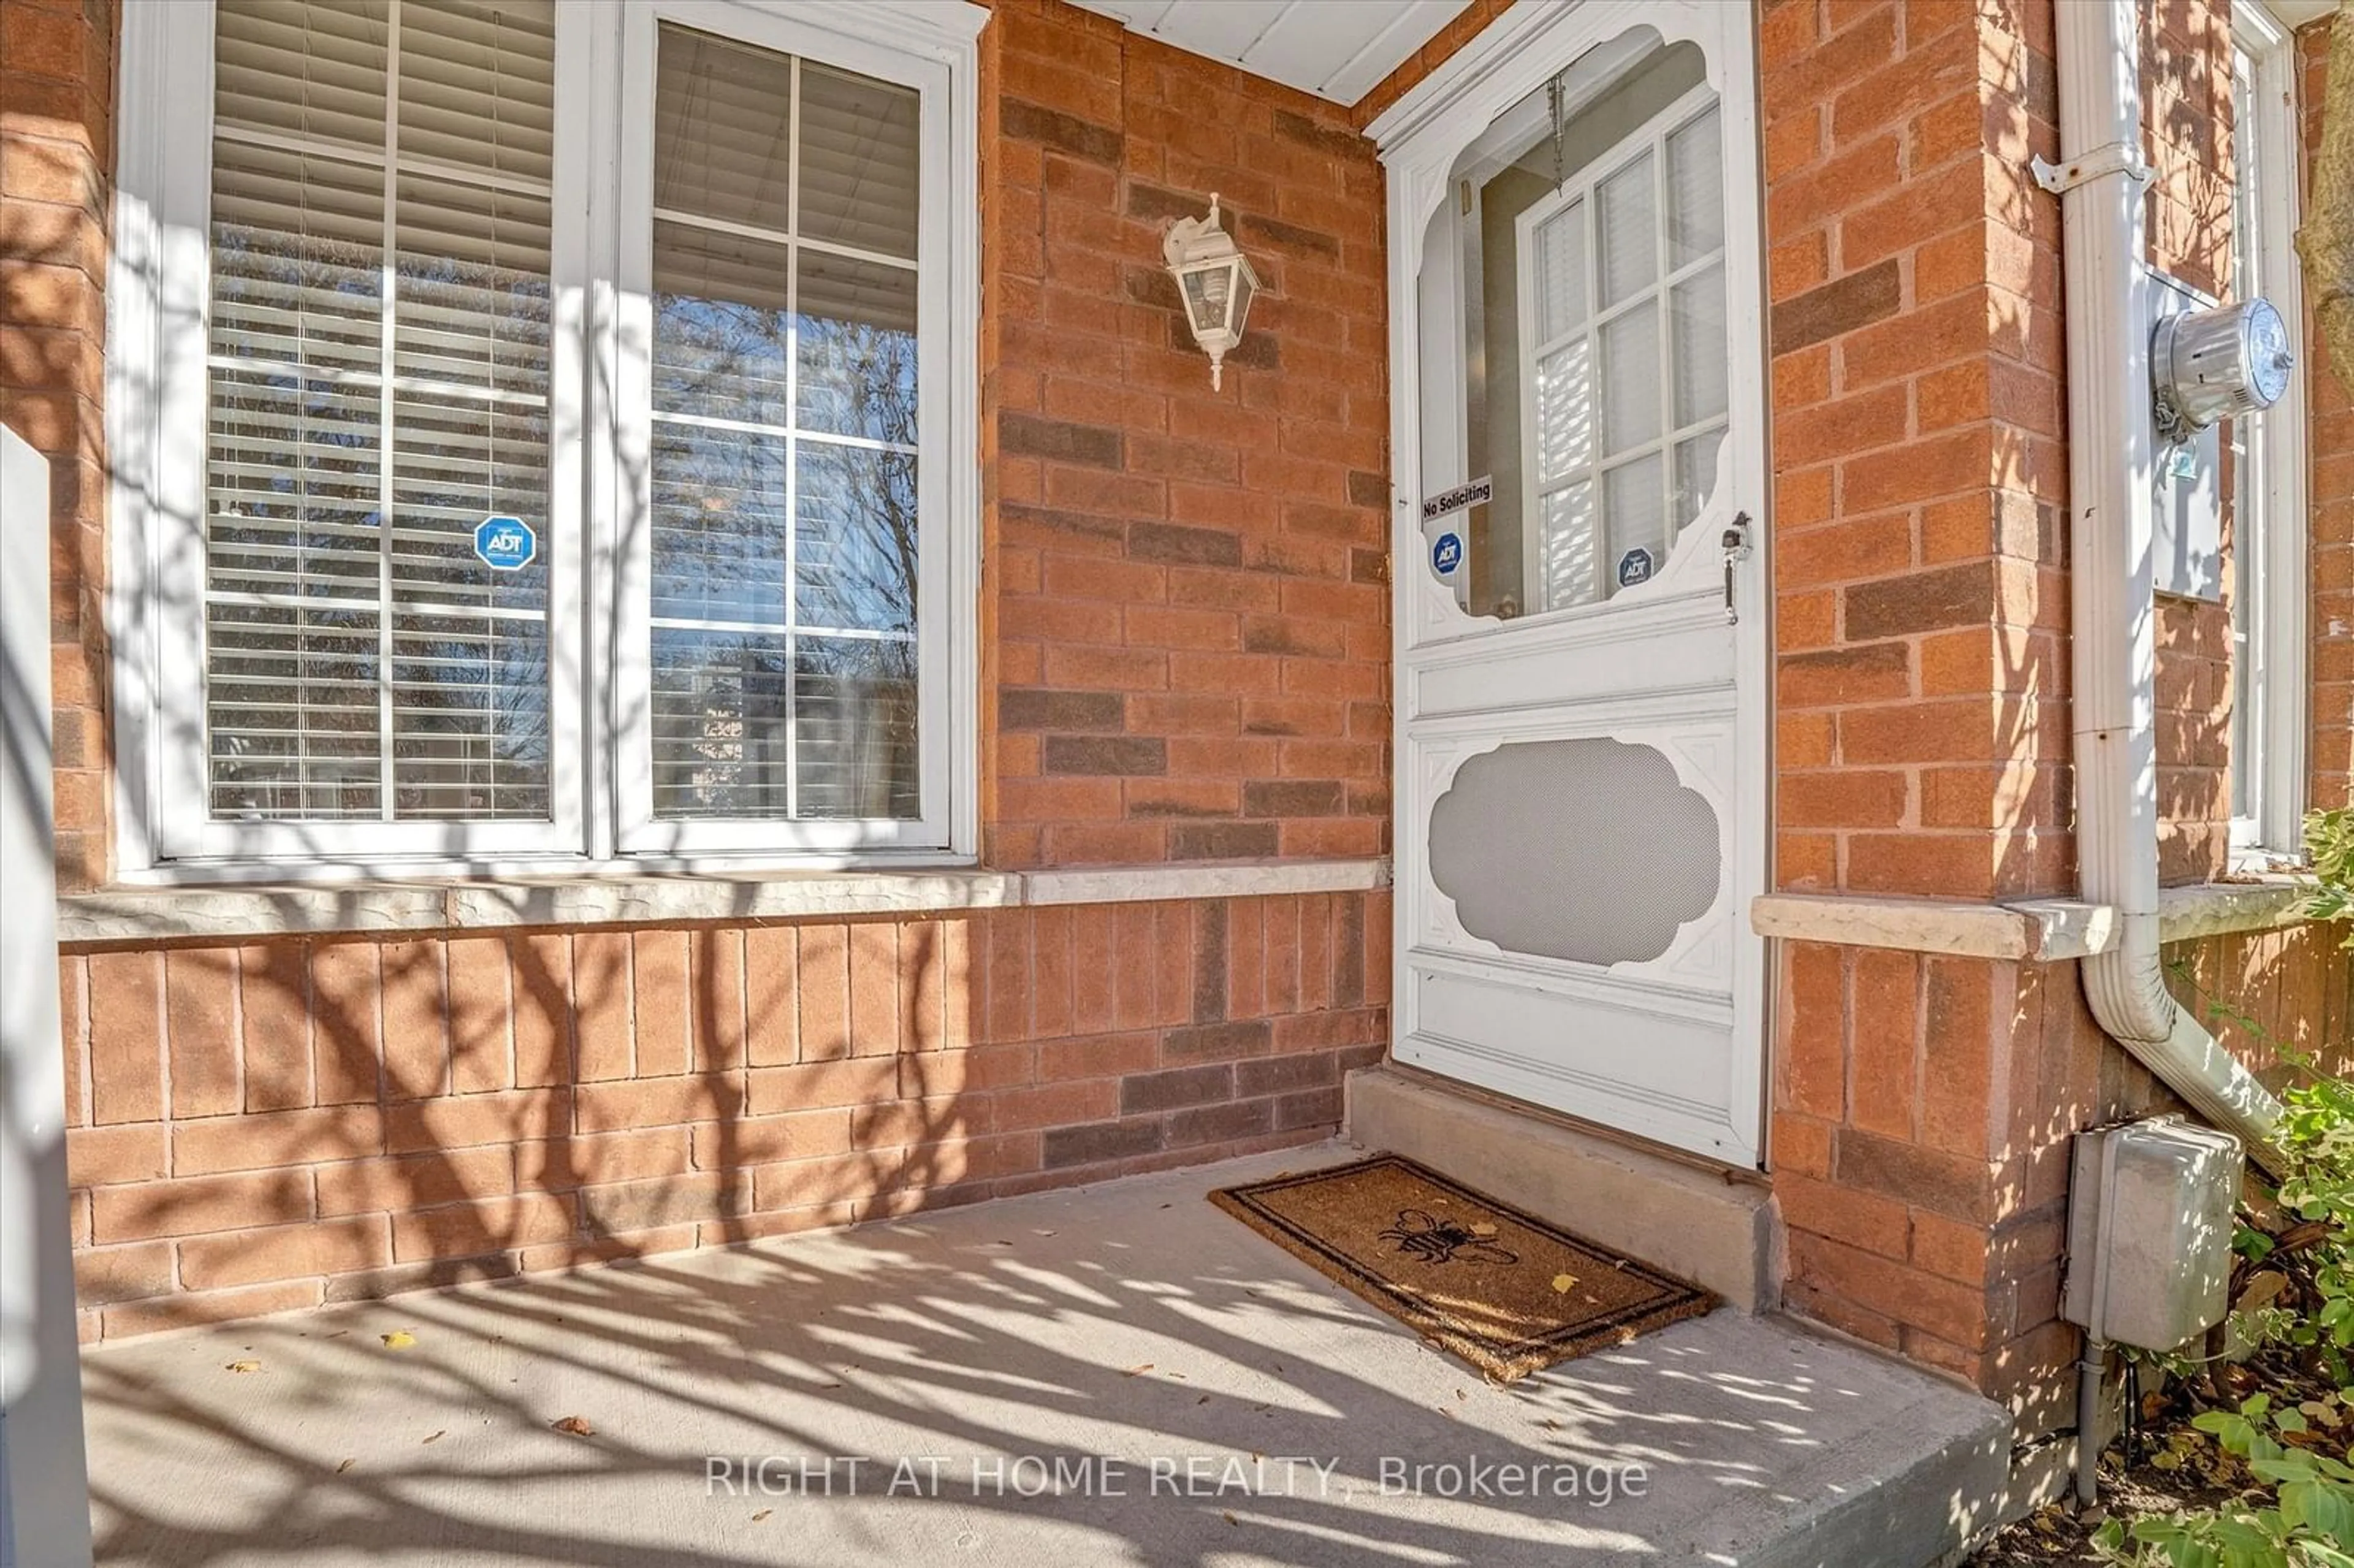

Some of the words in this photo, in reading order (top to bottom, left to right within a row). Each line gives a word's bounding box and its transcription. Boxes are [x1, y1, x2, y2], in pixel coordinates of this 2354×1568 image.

[1424, 503, 1437, 518] No
[1440, 483, 1490, 512] Soliciting
[487, 534, 523, 552] ADT
[1438, 545, 1457, 563] ADT
[1625, 561, 1647, 578] ADT
